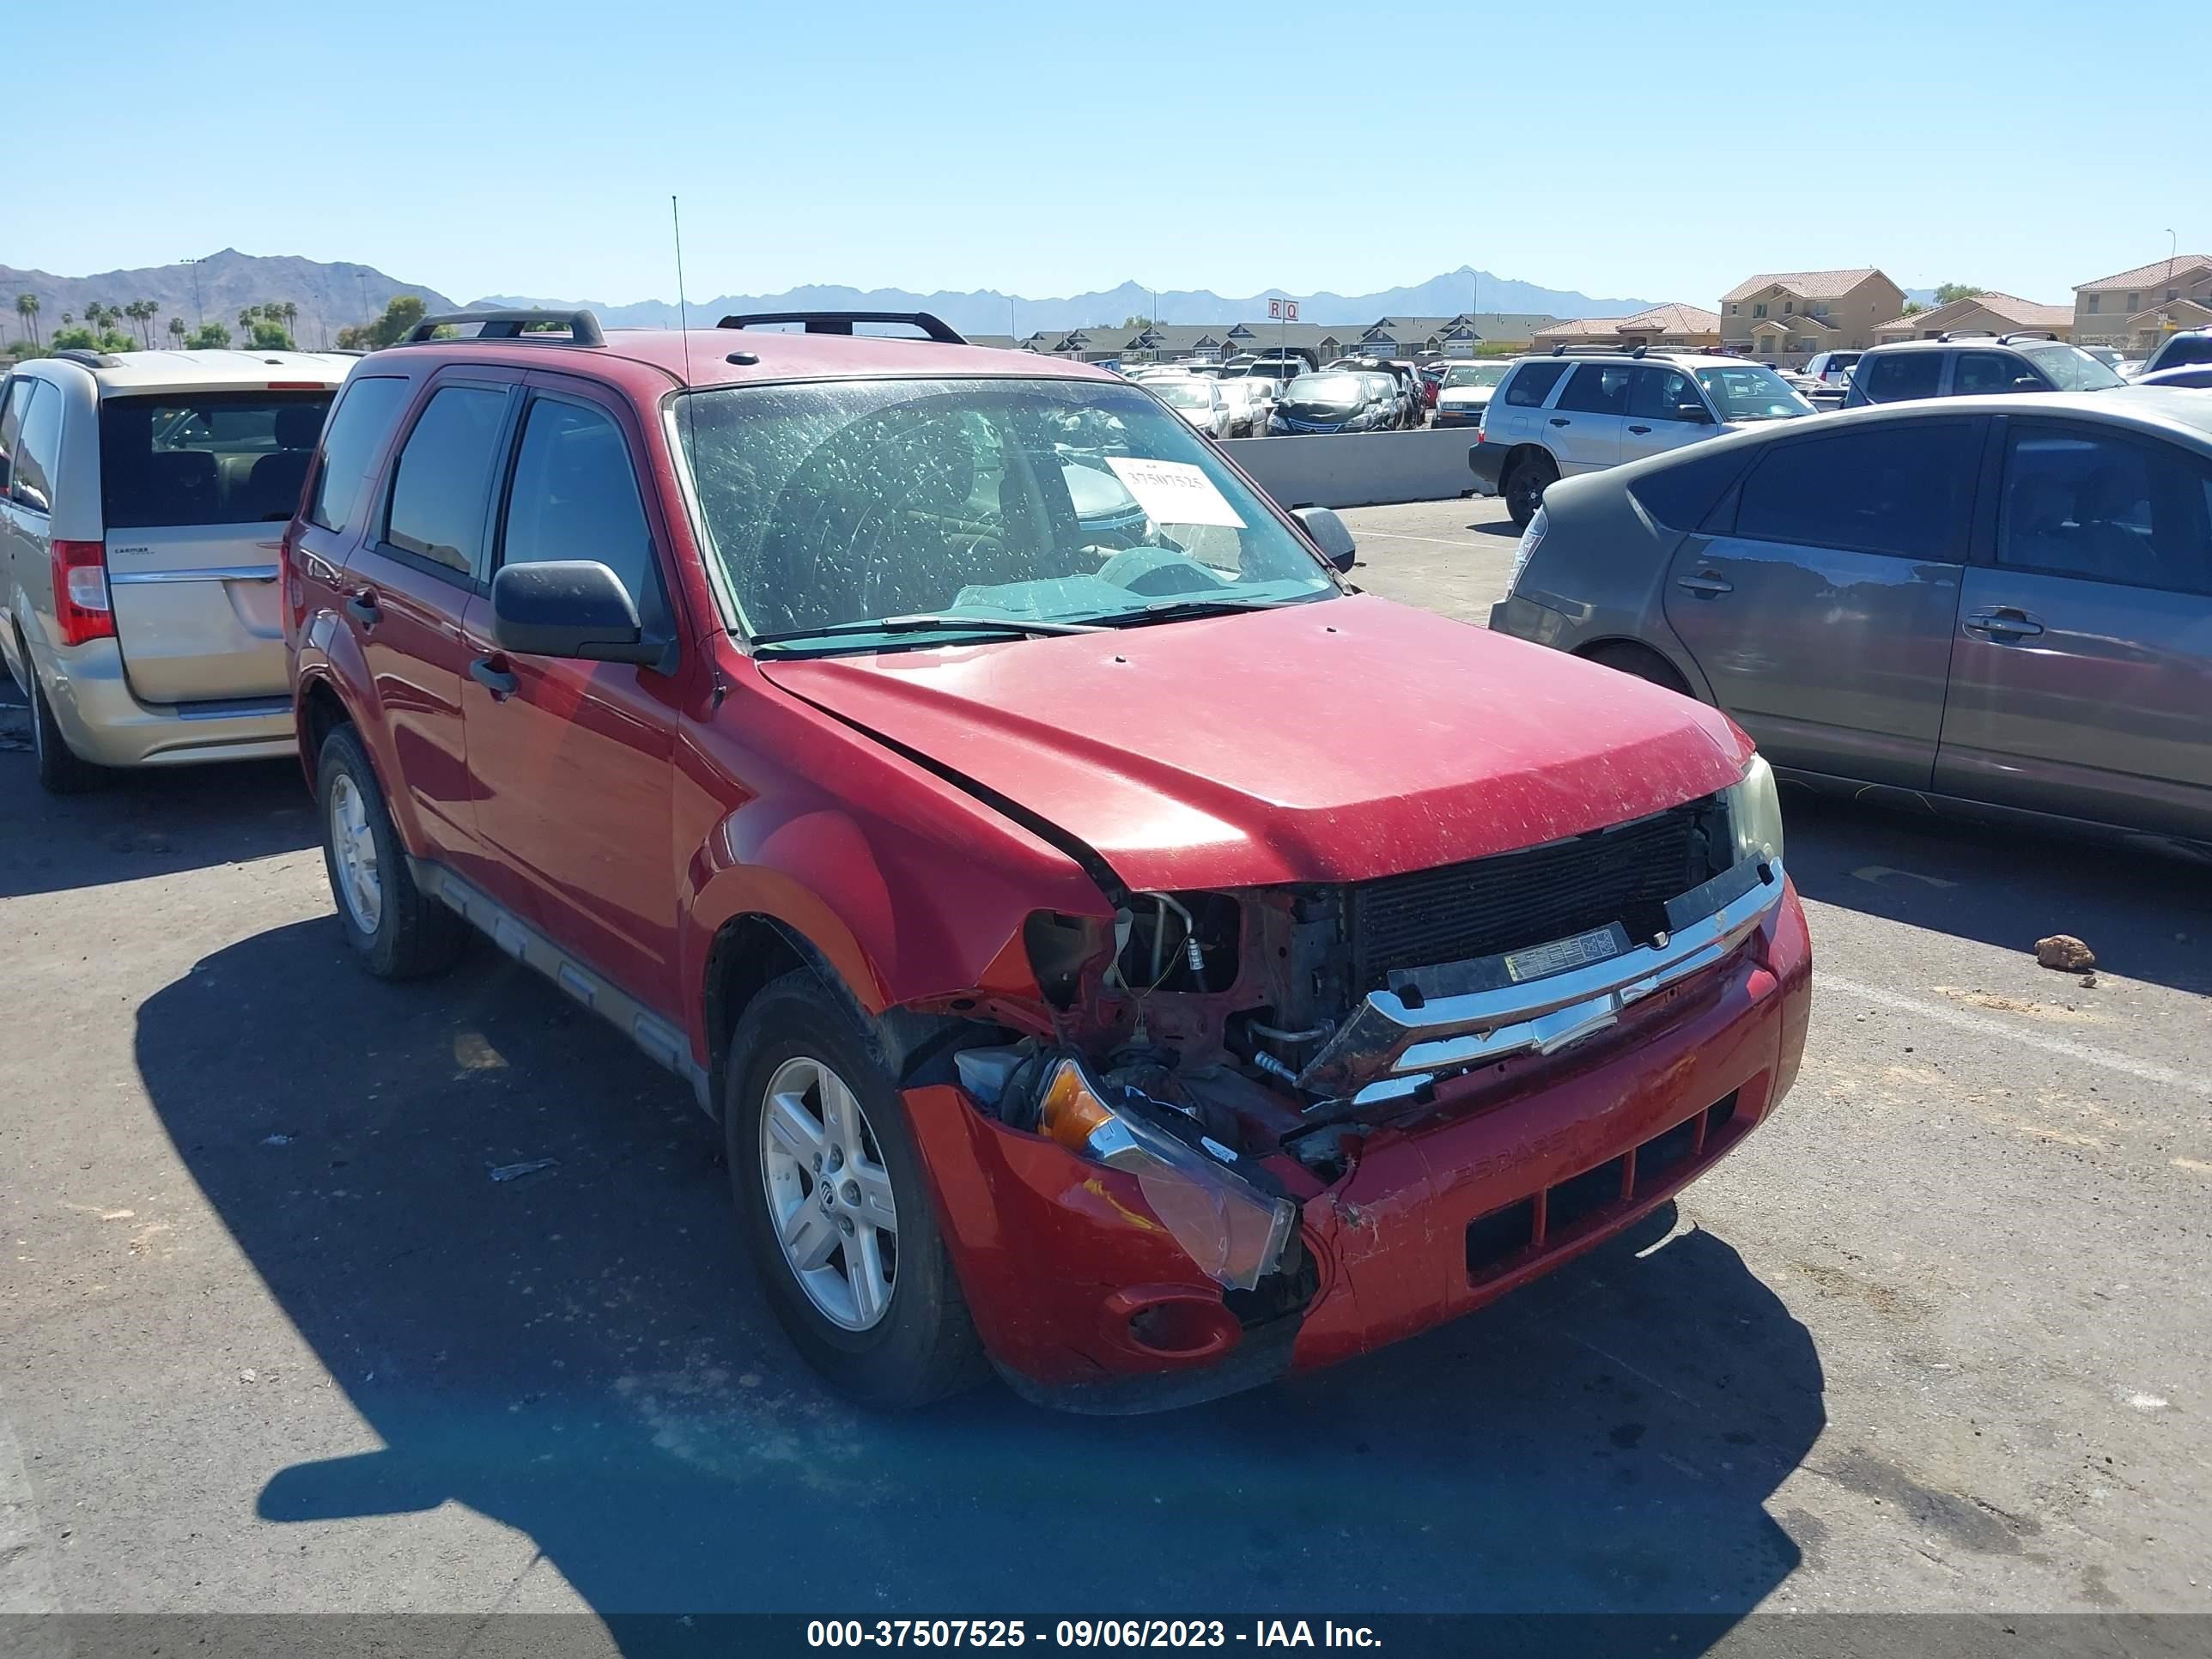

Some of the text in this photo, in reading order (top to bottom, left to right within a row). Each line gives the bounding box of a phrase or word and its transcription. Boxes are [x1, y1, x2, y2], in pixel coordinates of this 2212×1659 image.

[1271, 302, 1279, 317] R
[1287, 304, 1297, 319] Q
[1127, 471, 1205, 489] 37507525
